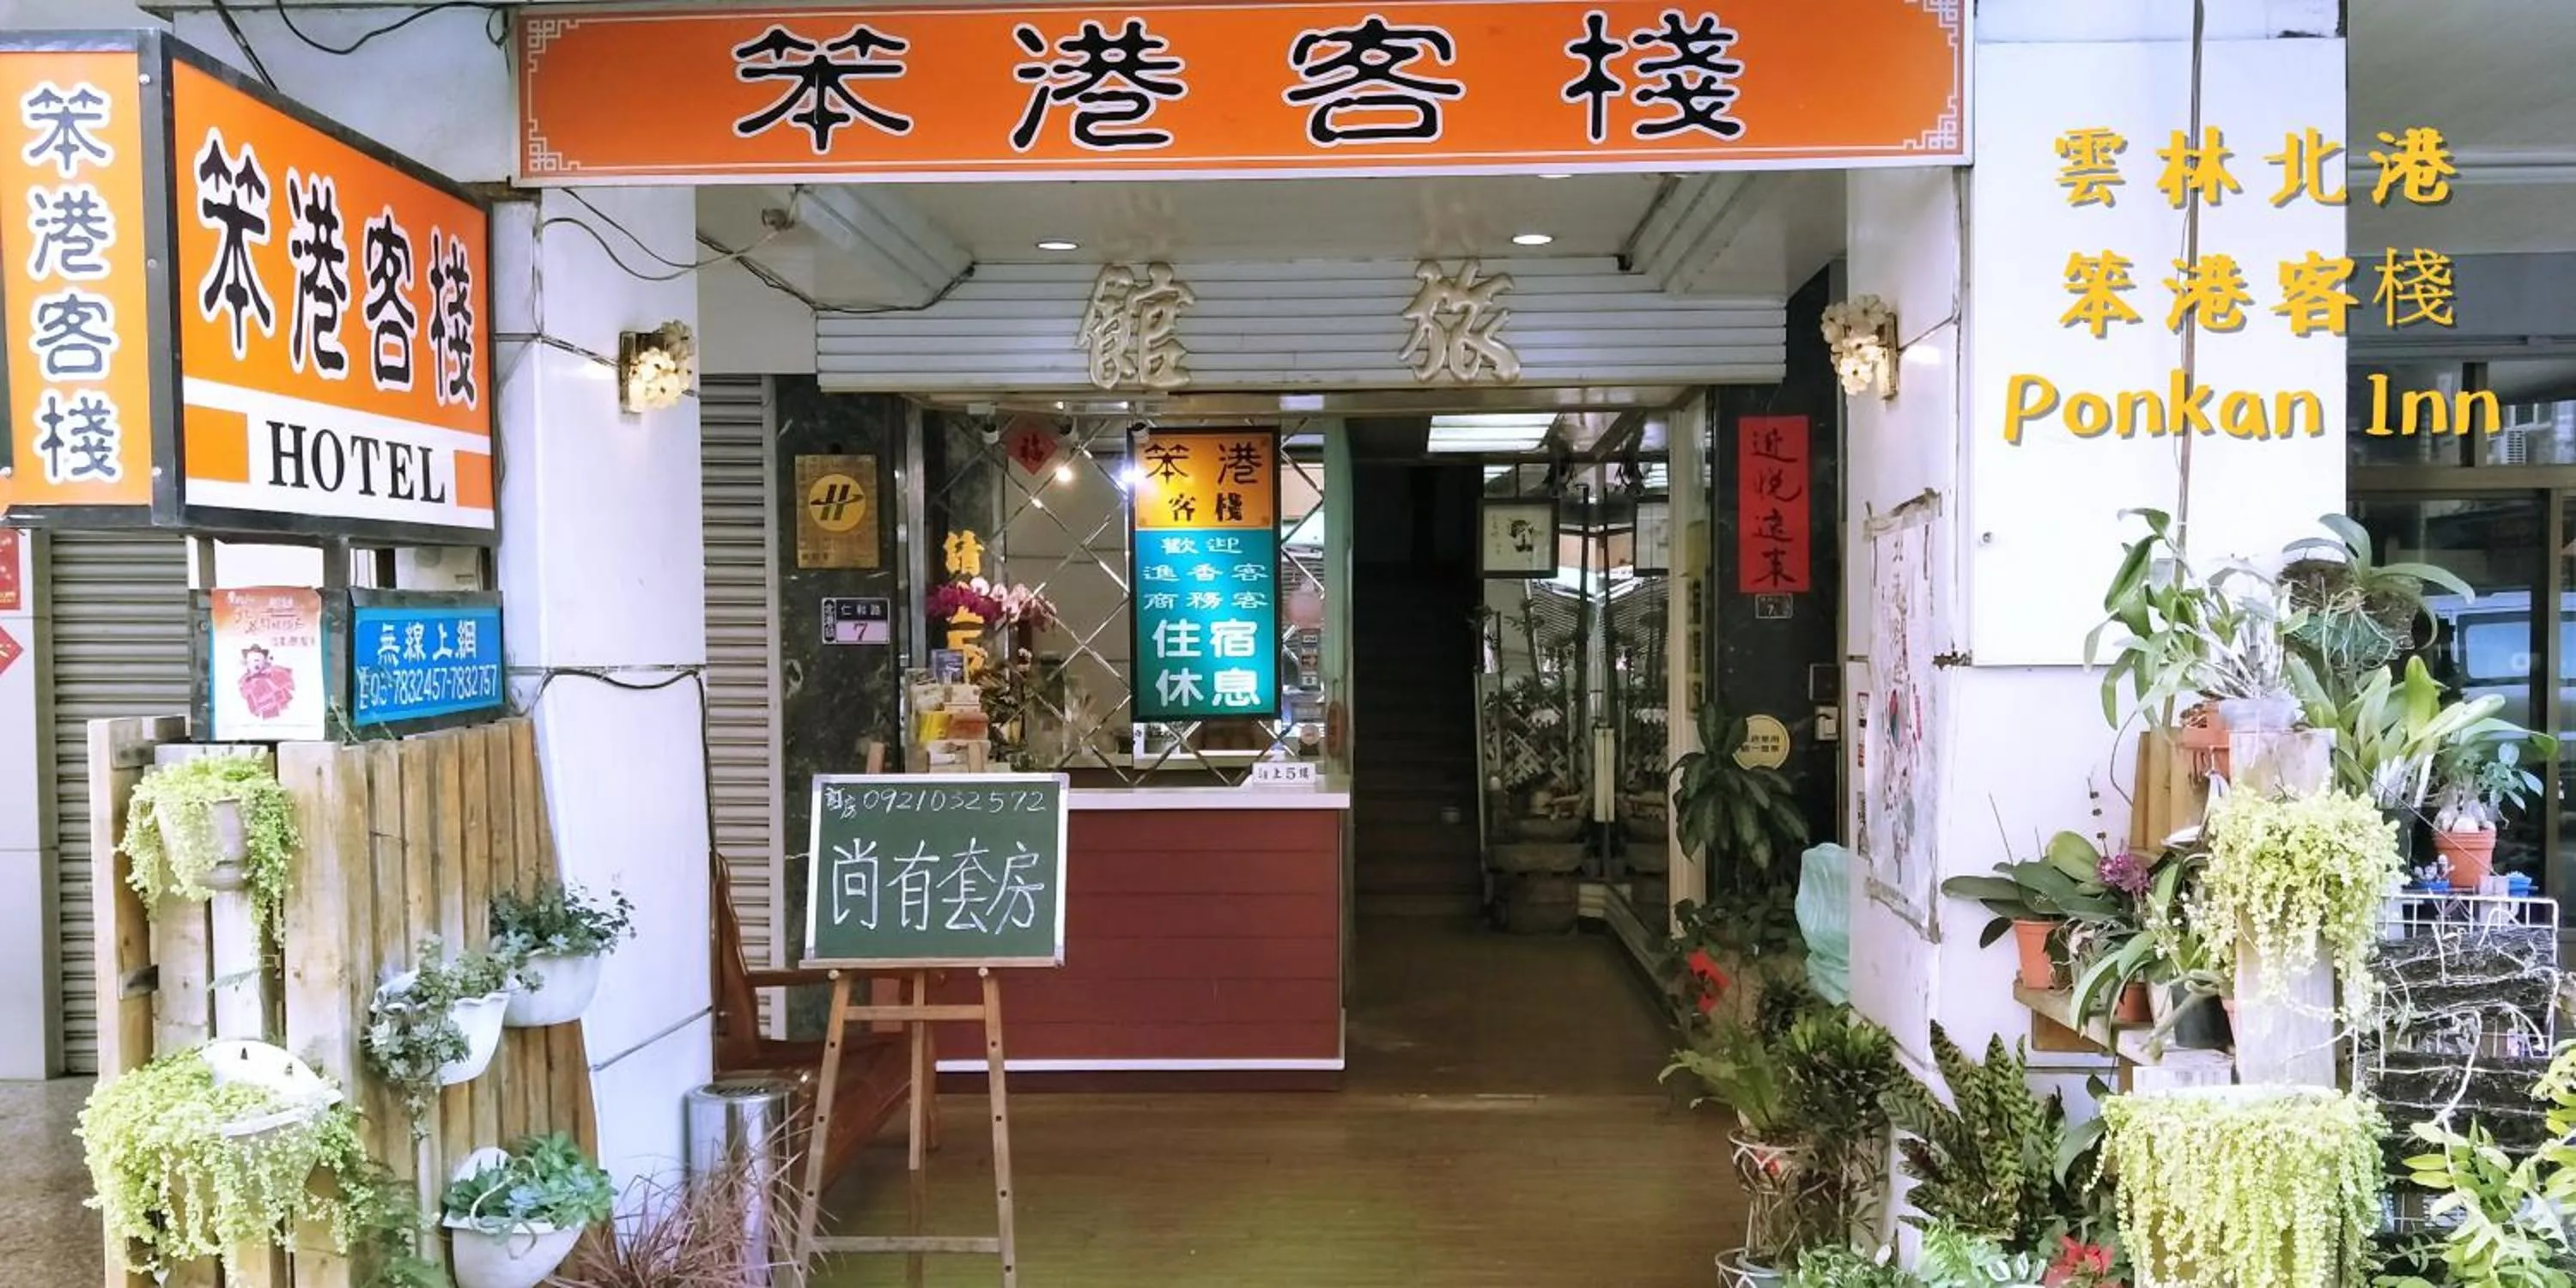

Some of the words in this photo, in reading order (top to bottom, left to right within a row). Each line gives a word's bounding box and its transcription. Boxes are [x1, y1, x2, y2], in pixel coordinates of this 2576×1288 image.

[733, 10, 1746, 154] 笨港客棧
[24, 84, 120, 483] 笨港客棧
[197, 135, 477, 405] 笨港客棧
[267, 421, 445, 505] HOTEL
[1145, 442, 1262, 485] 笨港
[1161, 537, 1243, 556] 歡迎
[1143, 592, 1268, 610] 商務客
[378, 620, 477, 666] 無線上網
[853, 623, 868, 641] 7
[1151, 618, 1258, 659] 住宿
[1156, 667, 1261, 707] 休息
[863, 789, 1047, 813] 0921032572
[833, 837, 1045, 935] 尚有套房
